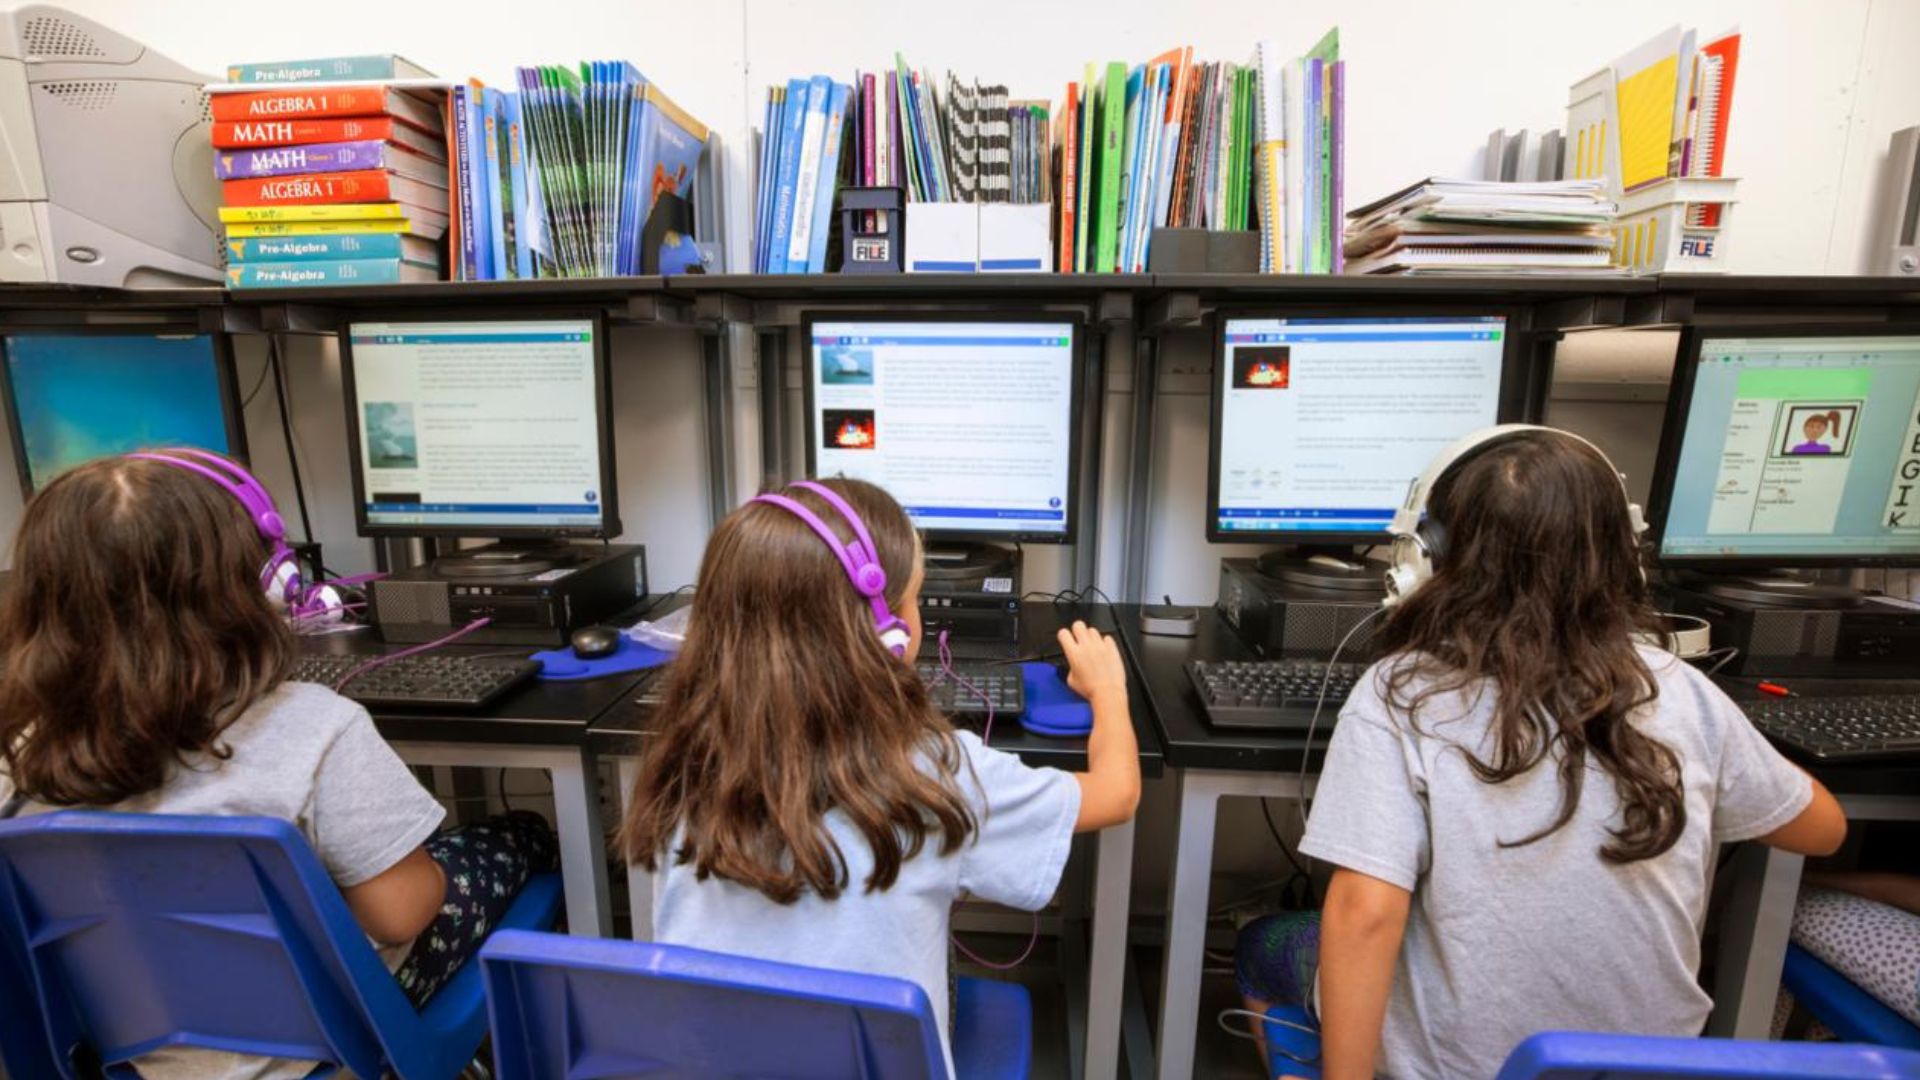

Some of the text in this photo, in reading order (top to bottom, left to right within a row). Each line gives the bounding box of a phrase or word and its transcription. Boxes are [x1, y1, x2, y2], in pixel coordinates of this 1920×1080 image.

[255, 68, 321, 81] Pre-Algebra
[249, 95, 327, 115] ALGEBRA 1
[233, 122, 293, 142] MATH
[250, 150, 307, 170] MATH
[260, 181, 333, 200] ALGEBRA 1
[258, 242, 328, 255] Pre-Algebra
[856, 245, 885, 259] FILE
[1679, 241, 1713, 256] FILE
[256, 269, 326, 282] Pre-Algebra
